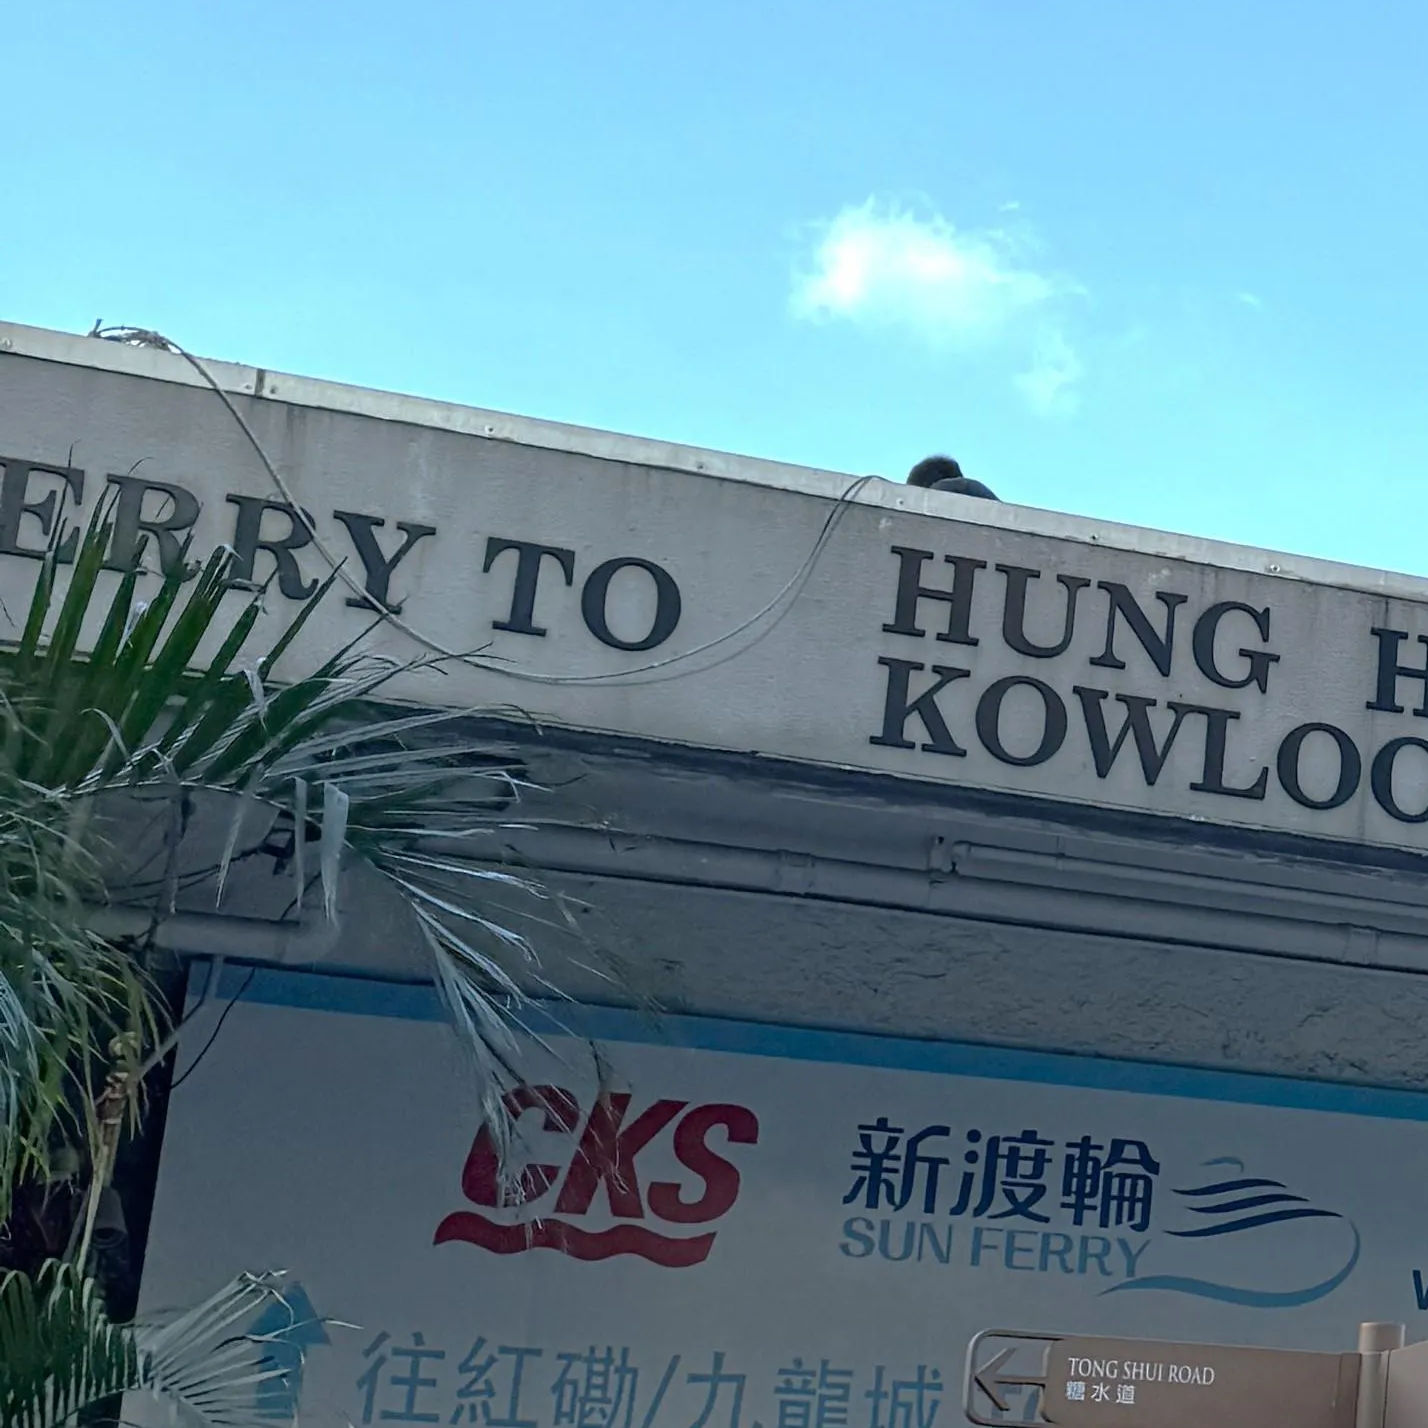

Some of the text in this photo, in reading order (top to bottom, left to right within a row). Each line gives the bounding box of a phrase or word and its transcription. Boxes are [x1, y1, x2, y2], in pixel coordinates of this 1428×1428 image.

[482, 537, 682, 653] TO
[881, 545, 1281, 694] HUNG
[461, 1084, 758, 1224] CKS
[842, 1117, 1160, 1232] 新渡輪
[838, 1216, 1151, 1278] SUN FERRY
[1065, 1381, 1136, 1405] 糖水道
[1068, 1357, 1215, 1385] TONG SHUI ROAD
